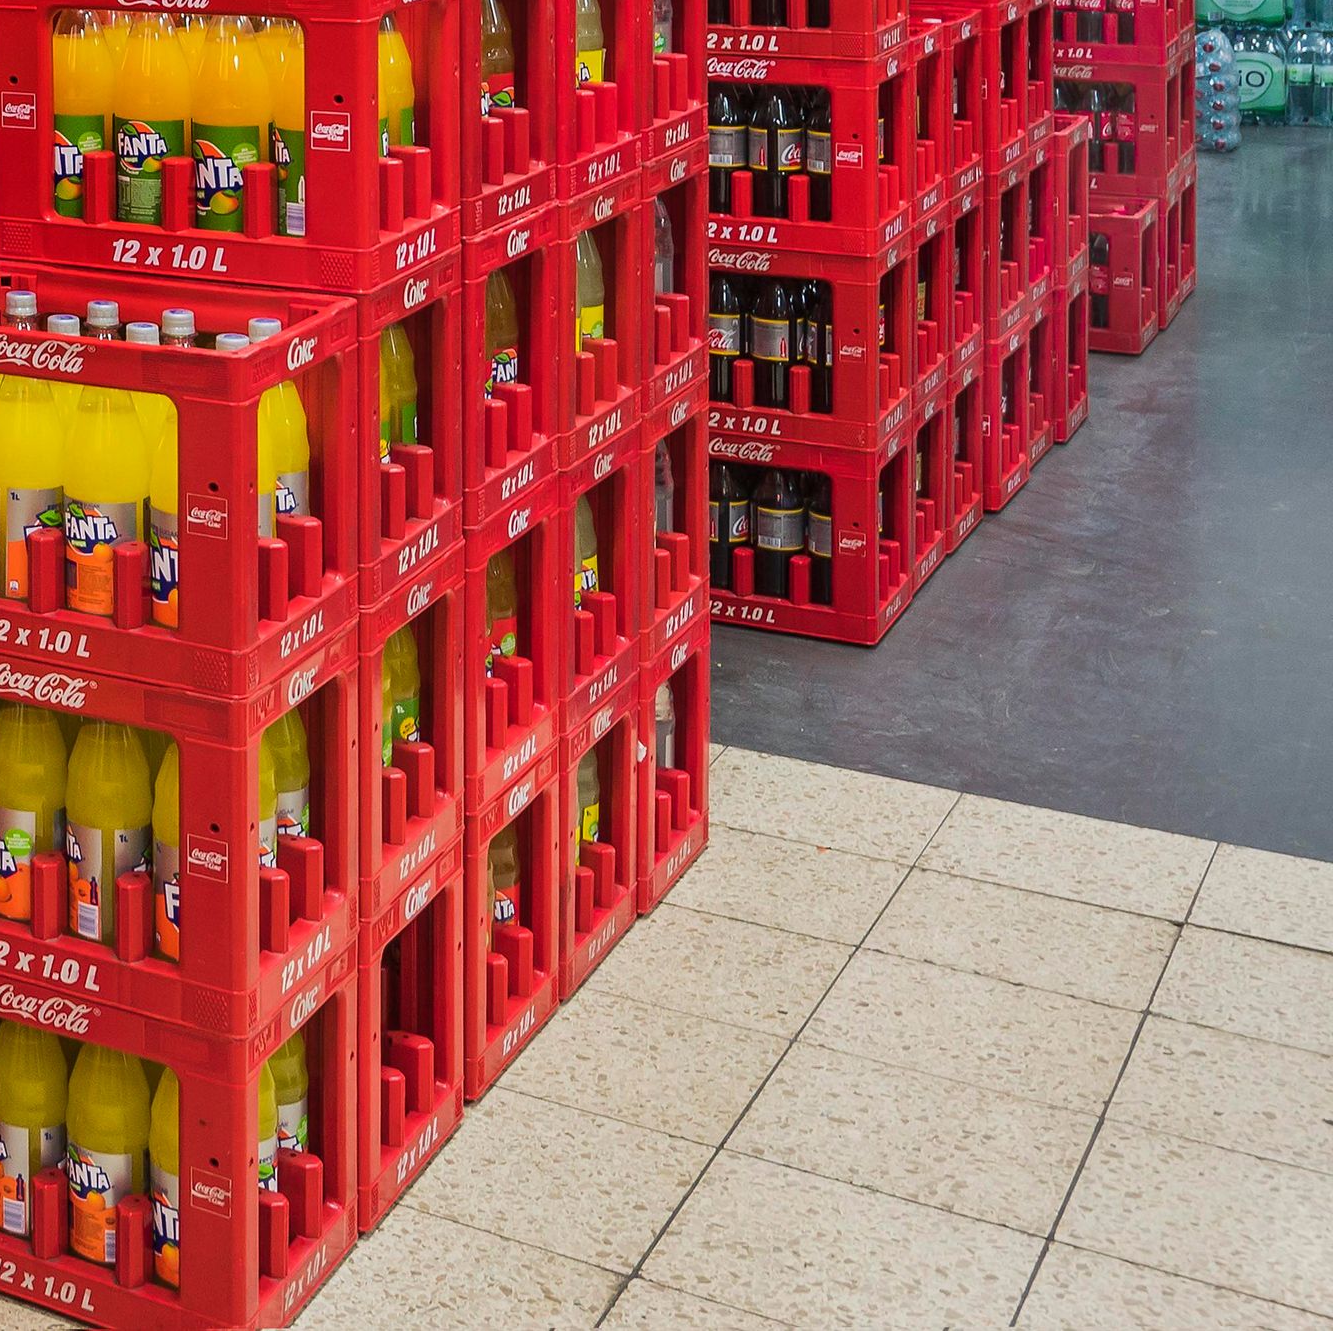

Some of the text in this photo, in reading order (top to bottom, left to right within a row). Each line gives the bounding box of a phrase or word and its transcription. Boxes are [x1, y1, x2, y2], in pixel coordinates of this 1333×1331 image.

[113, 239, 228, 272] 12 x 1.0 L
